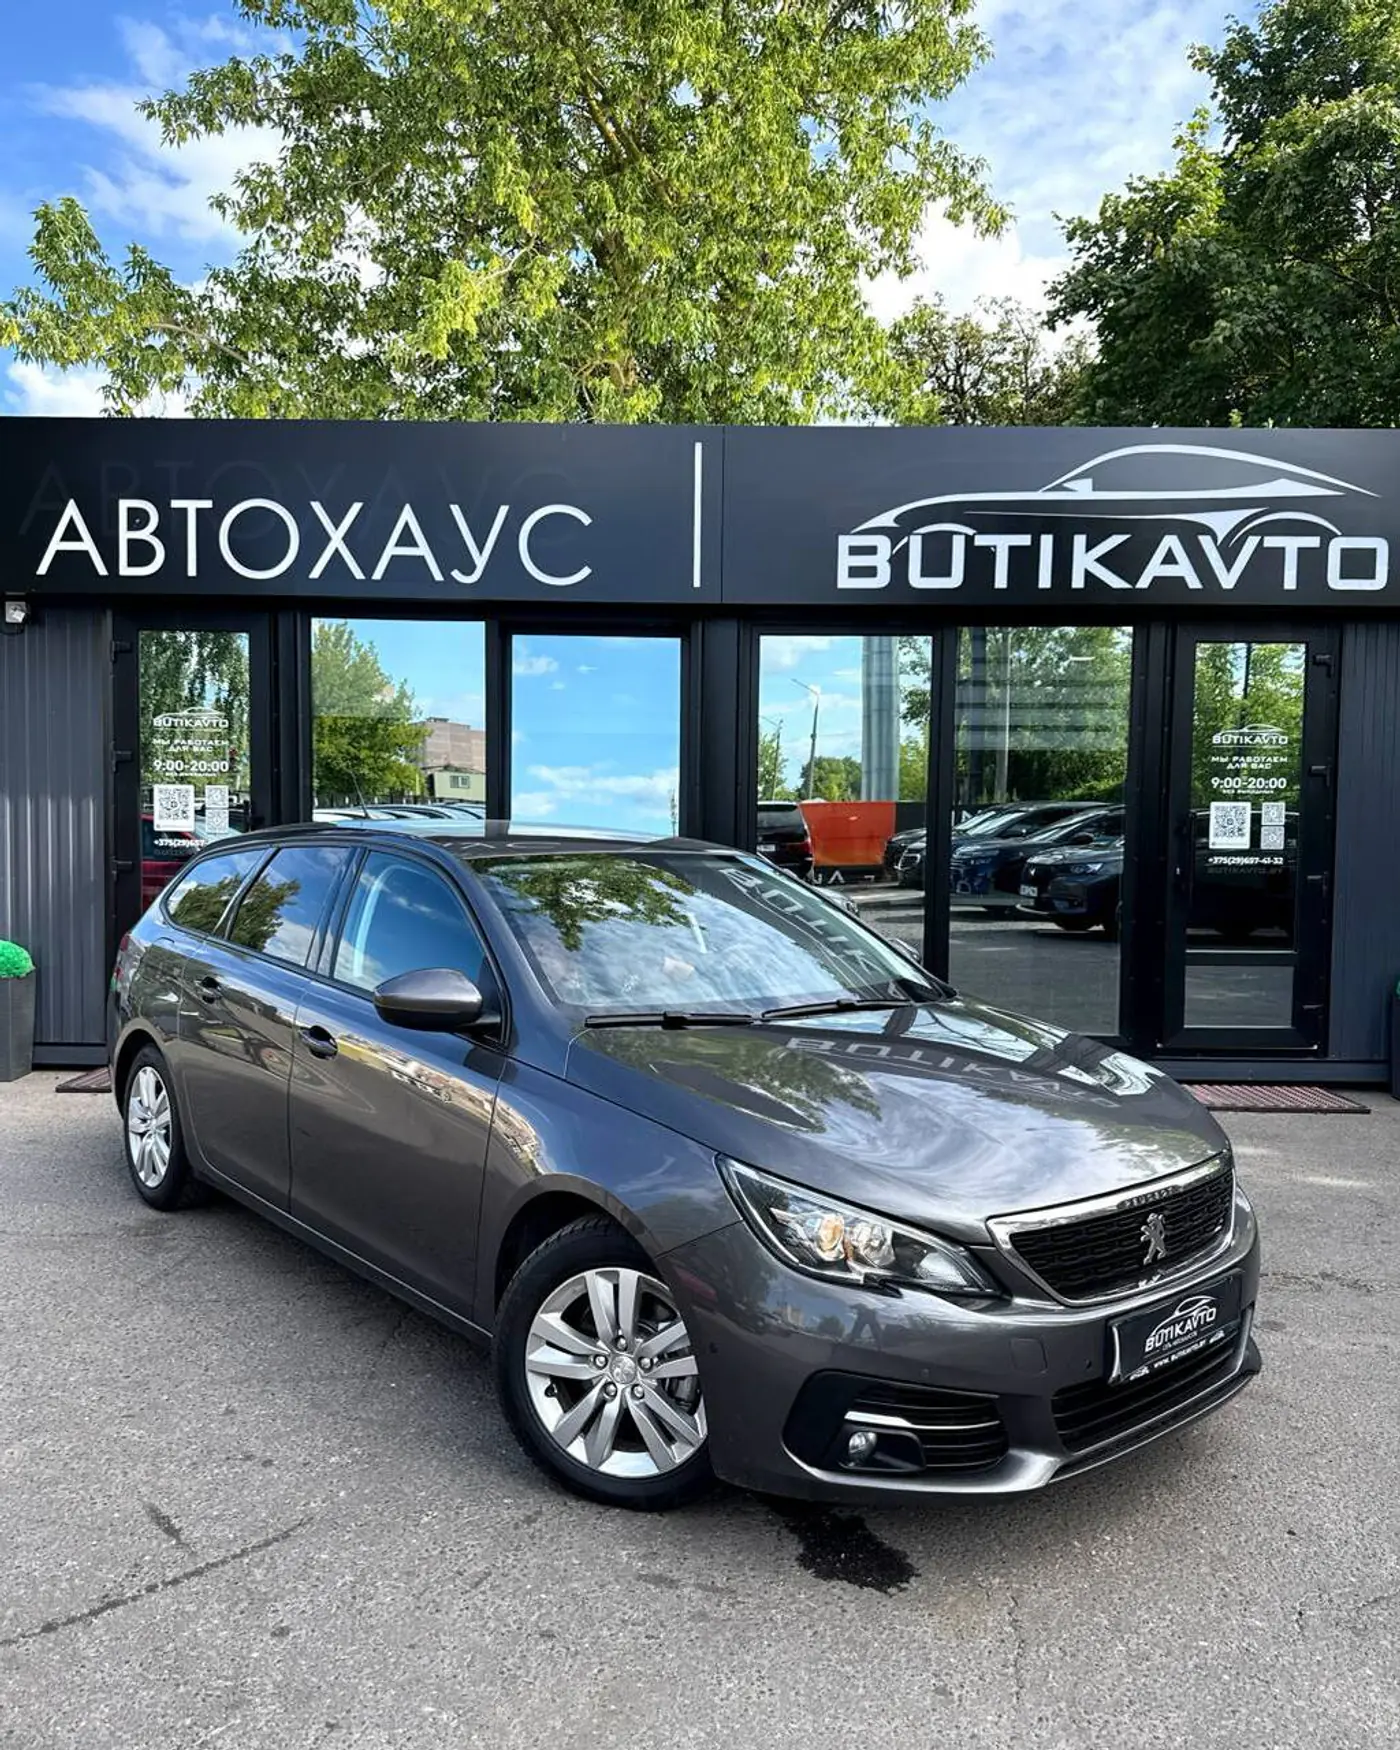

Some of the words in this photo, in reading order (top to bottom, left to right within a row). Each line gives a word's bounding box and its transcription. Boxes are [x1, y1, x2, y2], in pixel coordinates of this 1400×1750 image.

[36, 498, 593, 587] АВТОХАУС
[836, 534, 1389, 591] BUTIKAVTO
[153, 718, 229, 728] BUTIKAVTO
[1212, 735, 1288, 745] BUTIKAVTO
[153, 760, 229, 773] 9:00-20:00
[1211, 776, 1287, 789] 9:00-20:00
[1144, 1307, 1217, 1352] BUTIKAVTO
